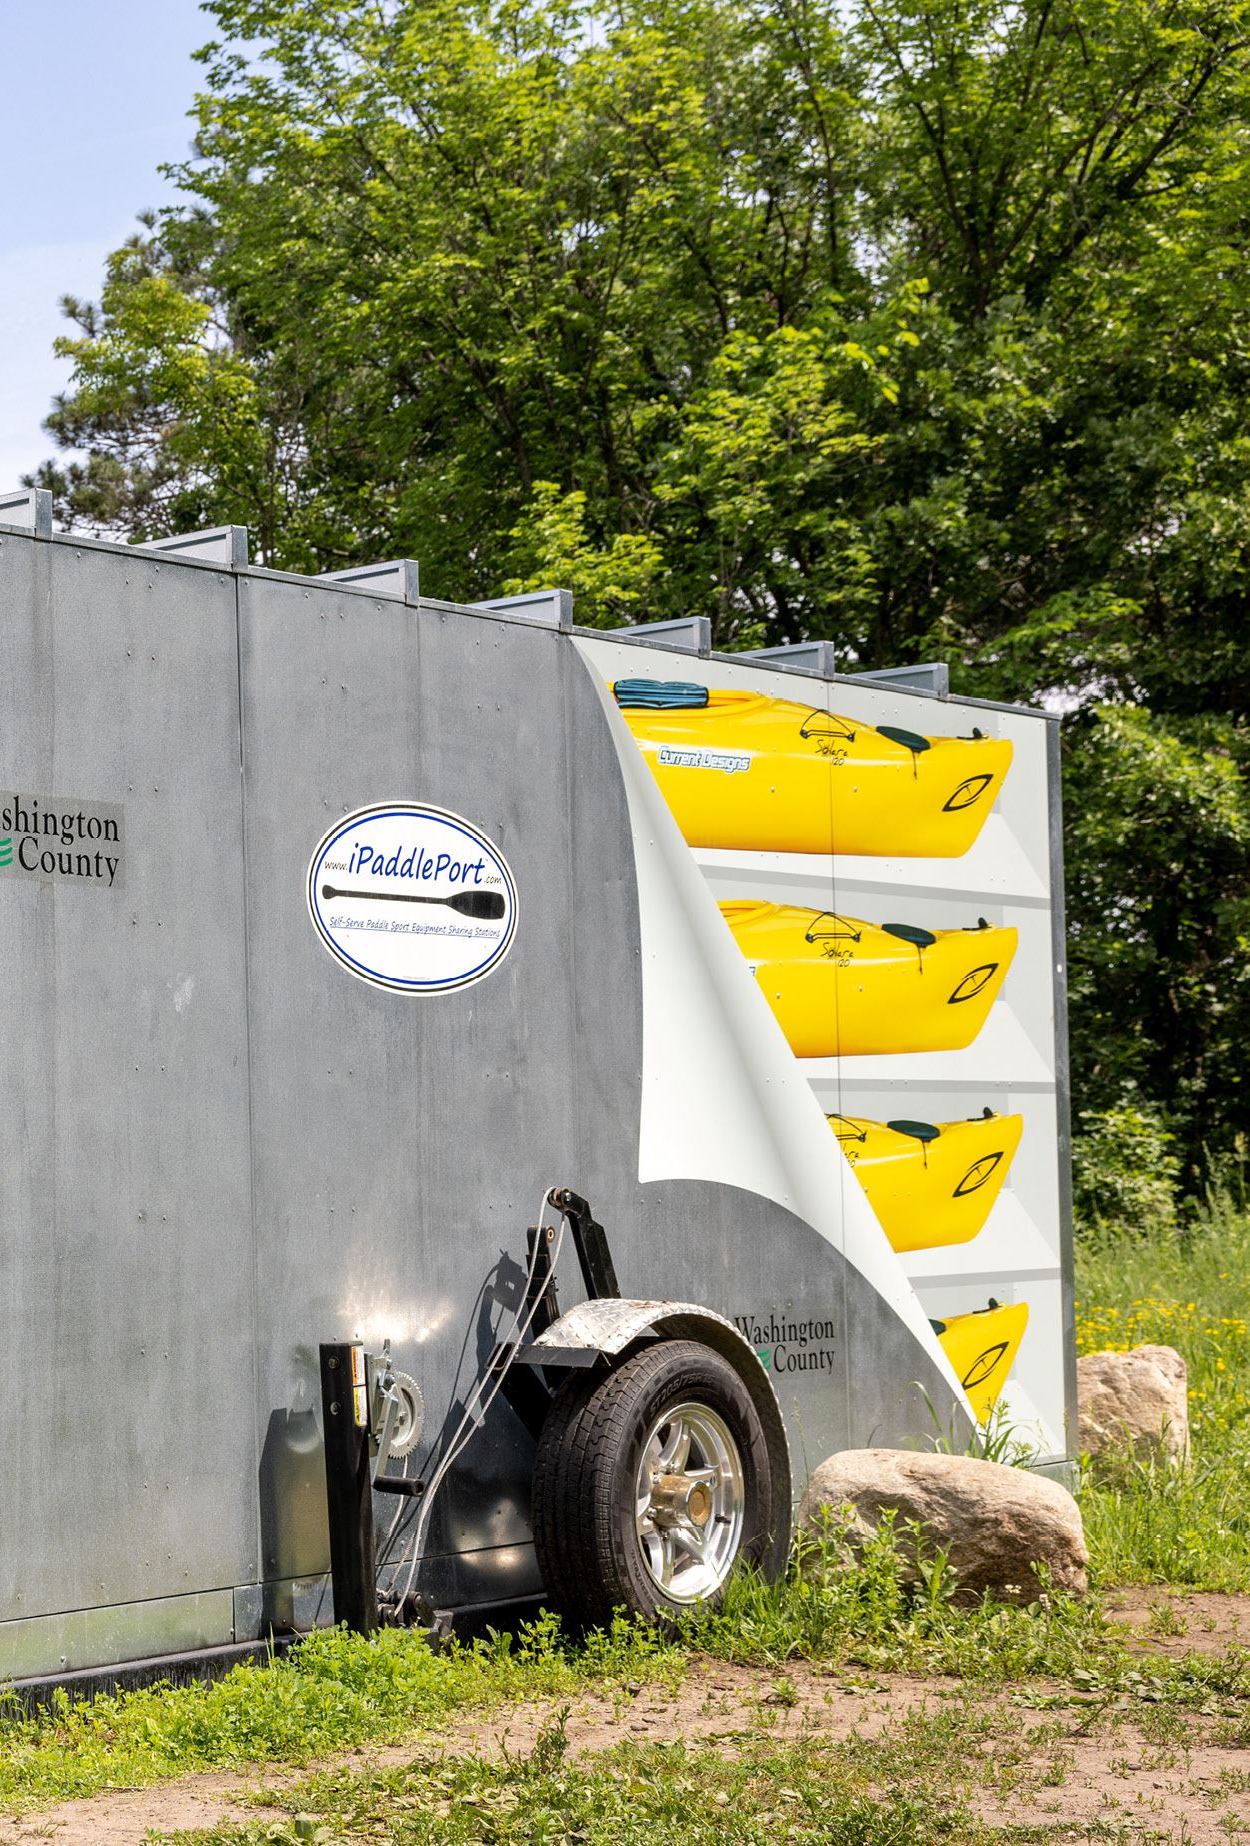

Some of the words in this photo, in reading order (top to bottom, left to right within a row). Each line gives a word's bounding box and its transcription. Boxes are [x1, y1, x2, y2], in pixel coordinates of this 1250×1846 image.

[657, 745, 701, 768] Current
[701, 750, 751, 774] Designs
[18, 835, 120, 887] County
[329, 916, 364, 928] Self-Serve
[366, 919, 388, 930] Paddle
[391, 920, 410, 932] Sport
[411, 922, 447, 935] Equipment
[448, 924, 474, 938] Sharing
[474, 926, 500, 938] Stations
[734, 1314, 835, 1347] Washington
[773, 1344, 835, 1375] County
